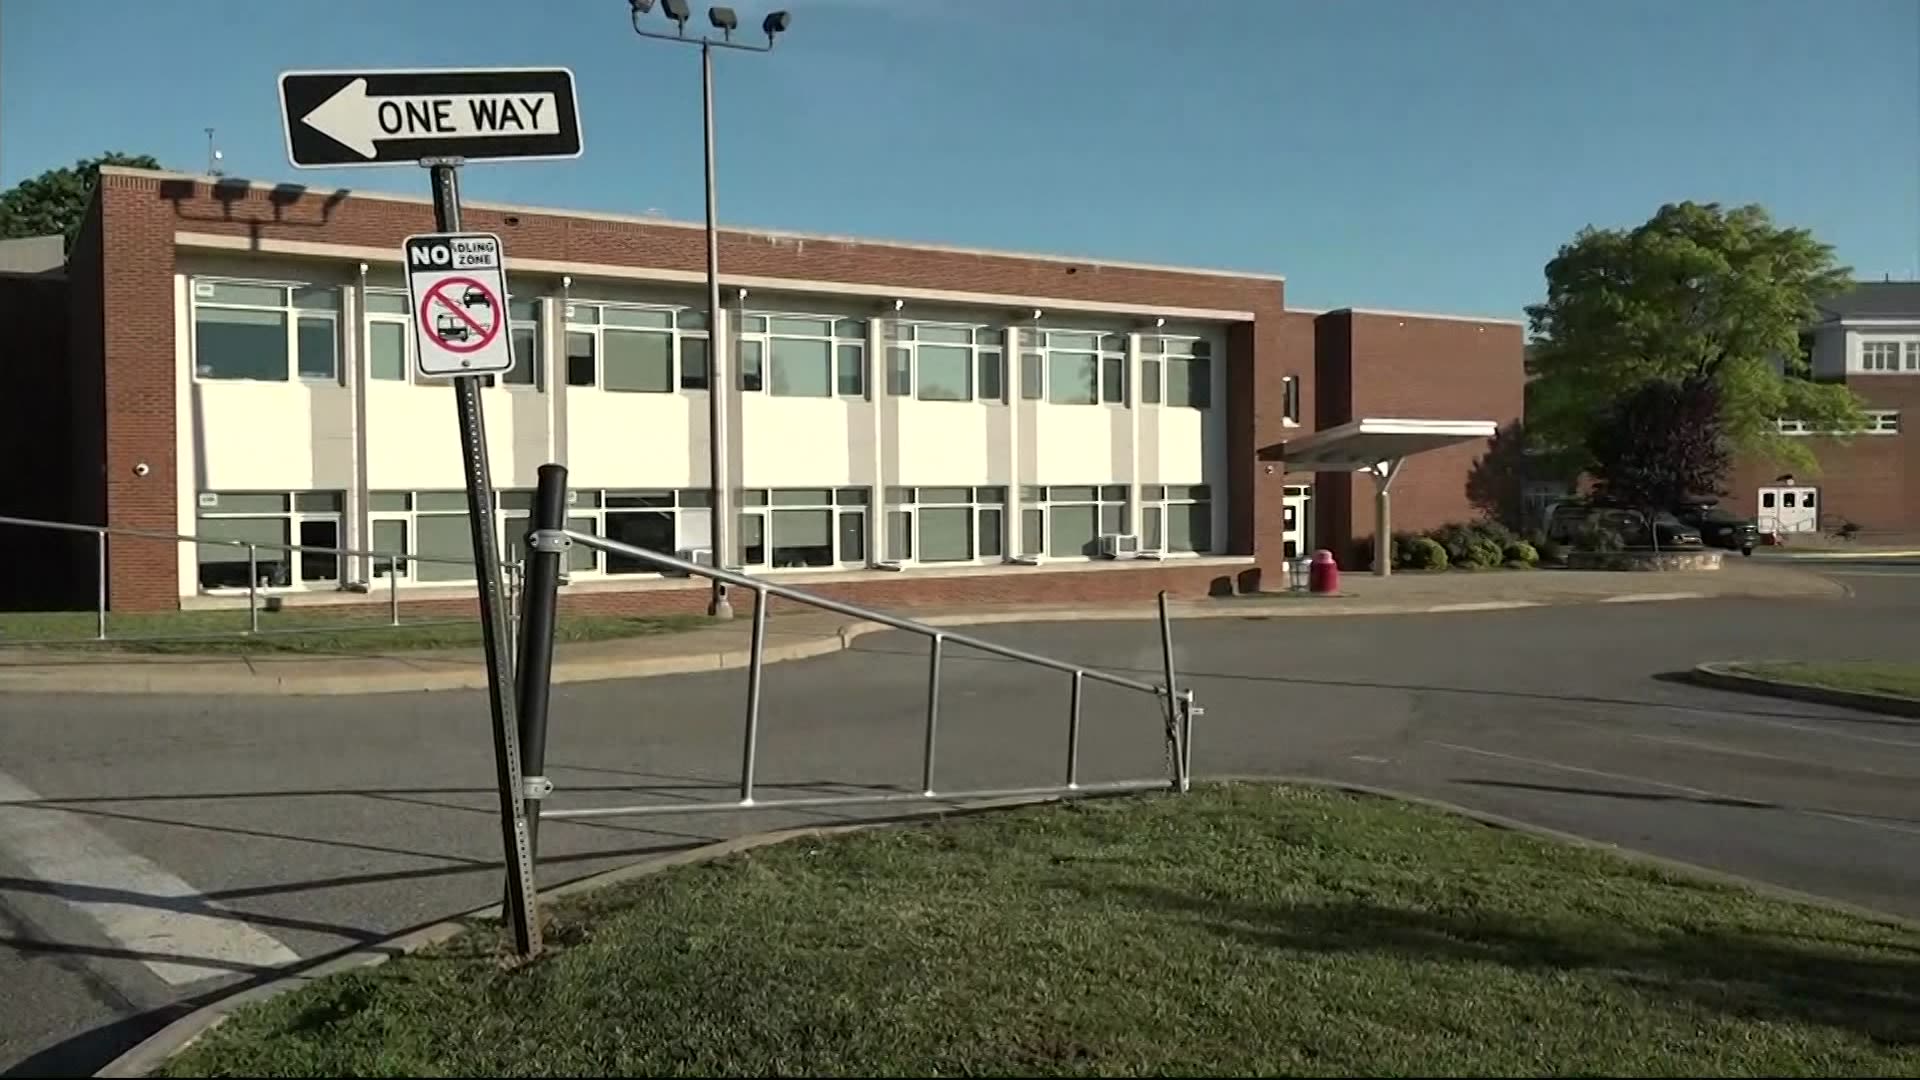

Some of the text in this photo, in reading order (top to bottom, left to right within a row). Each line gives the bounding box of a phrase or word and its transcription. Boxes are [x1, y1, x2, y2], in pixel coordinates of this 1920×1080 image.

[378, 98, 544, 134] ONE WAY
[411, 244, 450, 265] NO
[459, 254, 491, 265] ZONE
